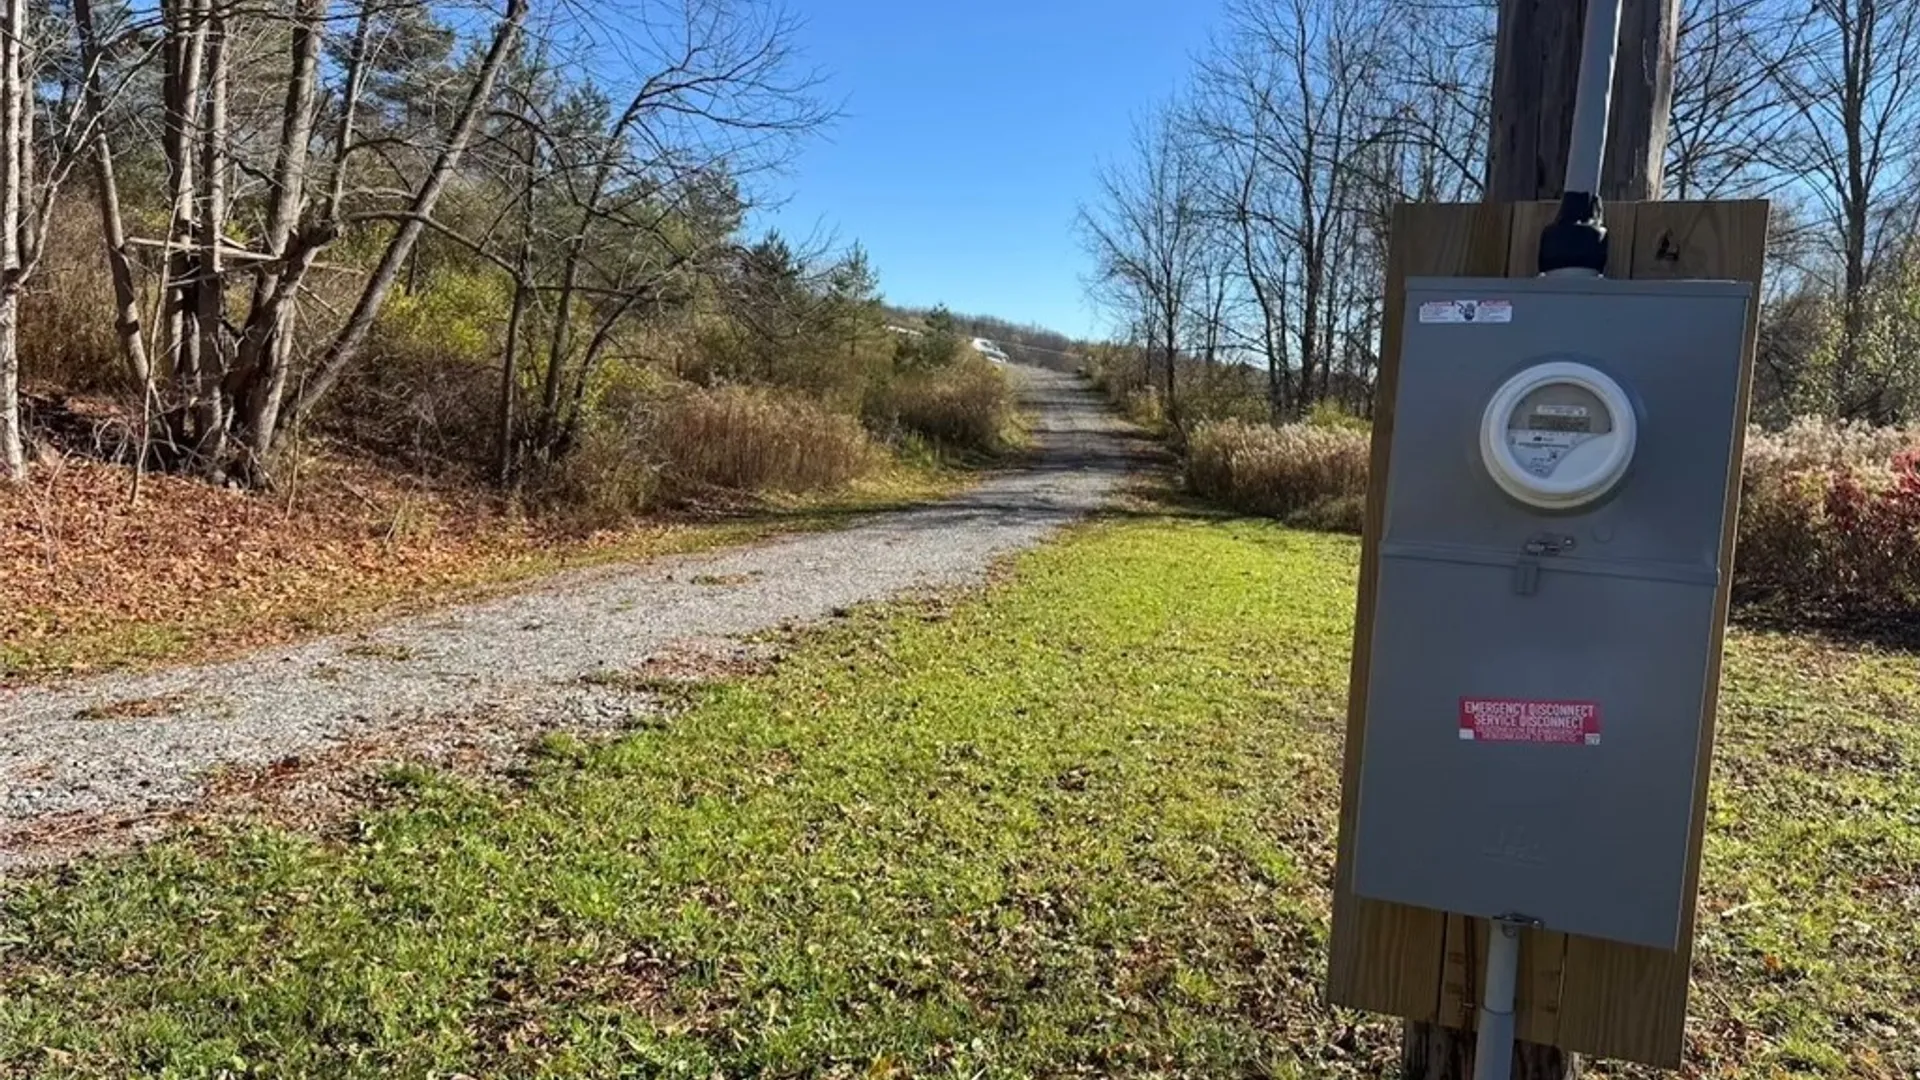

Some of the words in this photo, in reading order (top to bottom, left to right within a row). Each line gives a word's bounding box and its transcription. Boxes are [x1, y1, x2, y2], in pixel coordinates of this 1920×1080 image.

[1464, 701, 1526, 716] EMERGENCY
[1529, 703, 1594, 717] DISCONNECT
[1474, 715, 1517, 727] SERVICE
[1519, 716, 1585, 729] DISCONNECT
